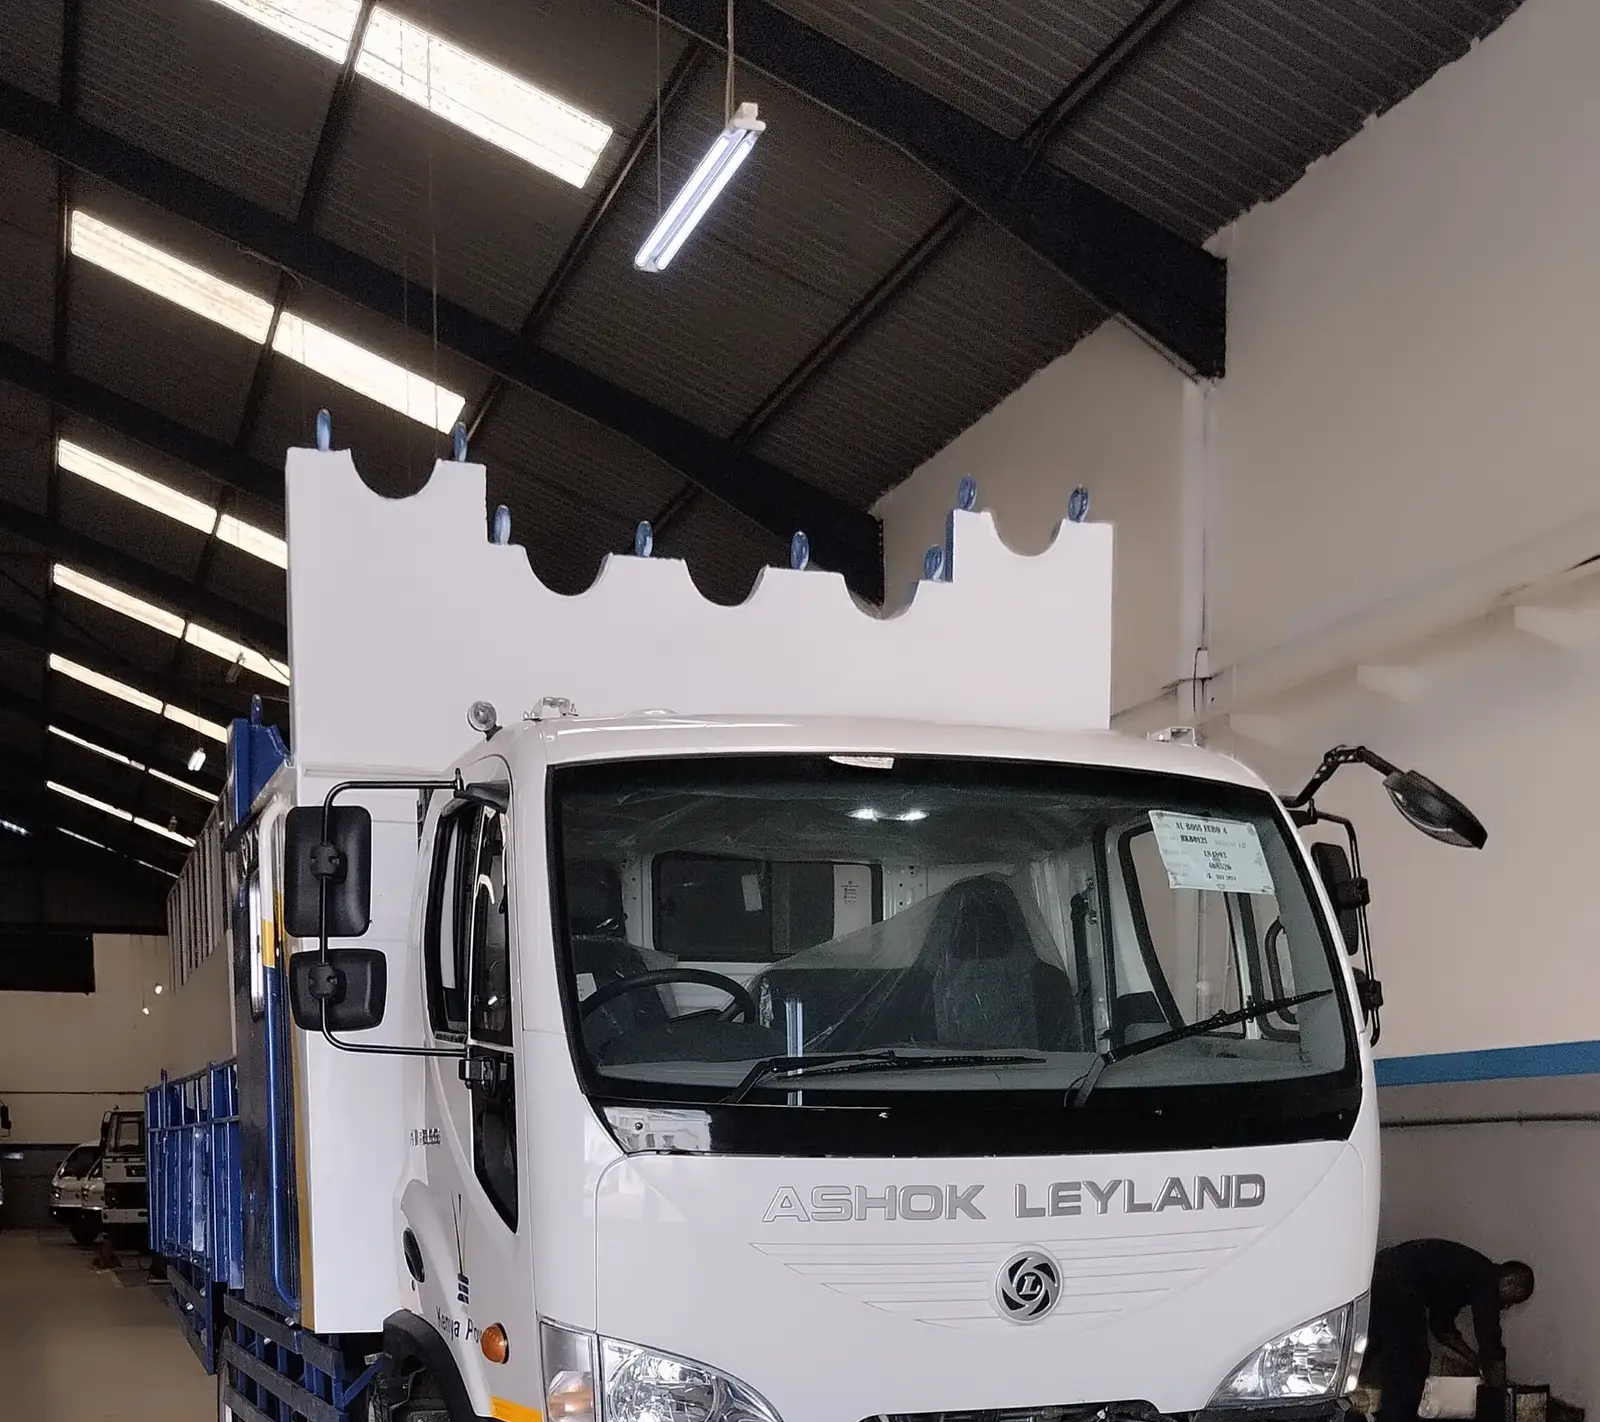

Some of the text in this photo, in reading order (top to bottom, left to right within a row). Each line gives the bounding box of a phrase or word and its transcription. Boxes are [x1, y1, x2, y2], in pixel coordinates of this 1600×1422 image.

[762, 1173, 1267, 1223] ASHOK LEYLAND
[1019, 1275, 1041, 1296] L
[435, 1306, 482, 1344] Kenya Po
